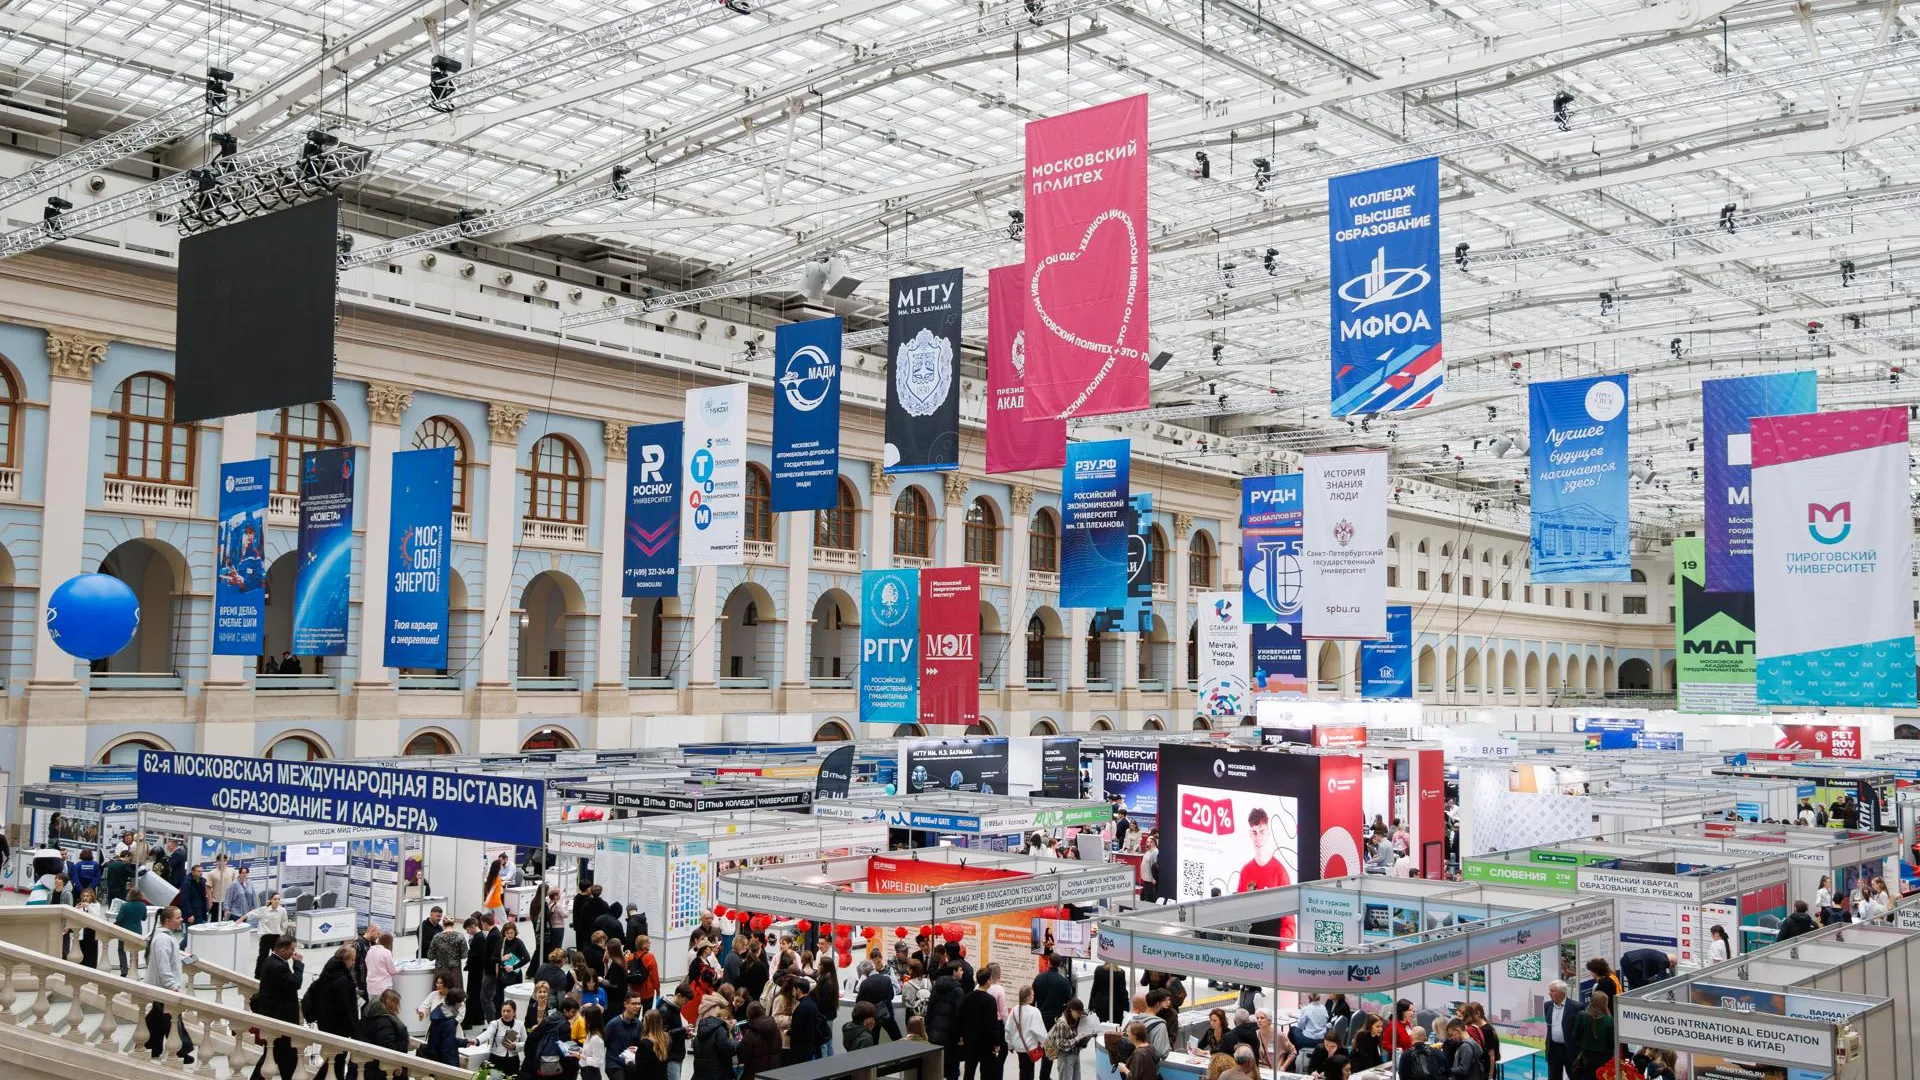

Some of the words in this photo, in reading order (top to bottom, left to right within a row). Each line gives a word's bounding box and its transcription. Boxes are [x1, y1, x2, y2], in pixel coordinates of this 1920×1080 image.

[1032, 139, 1137, 178] МОСКОВСКИЙ
[1349, 185, 1416, 208] КОЛЛЕДЖ
[1354, 204, 1412, 226] ВЫСШЕЕ
[1079, 210, 1108, 252] ПОЛИТЕХ
[1335, 214, 1431, 243] ОБРАЗОВАНИЕ
[1109, 207, 1138, 265] МОСКОВСКИЙ
[1045, 254, 1058, 265] ПО
[1031, 261, 1046, 297] ЛЮБВИ
[1126, 266, 1138, 306] ЛЮБВИ
[897, 282, 955, 309] МГТУ
[898, 308, 909, 316] ИМ.
[923, 303, 952, 313] БАУМАНА
[1122, 307, 1132, 323] ПО
[1033, 297, 1075, 345] МОСКОВСКИЙ
[1340, 308, 1432, 342] МФЮА
[1116, 325, 1127, 346] ЭТО
[1074, 337, 1113, 354] ПОЛИТЕХ
[1120, 347, 1138, 359] ЭТО
[808, 364, 836, 380] МАДИ
[1085, 355, 1117, 396] ПОЛИТЕХ
[1544, 424, 1605, 448] Лучшее
[707, 438, 713, 448] S
[1550, 446, 1604, 466] будущее
[696, 456, 709, 477] T
[1075, 459, 1117, 471] РЭУ.РФ
[1540, 460, 1617, 482] начинается
[1323, 468, 1366, 479] ИСТОРИЯ
[633, 483, 673, 497] РОСНОУ
[706, 482, 712, 492] E
[1326, 479, 1363, 490] ЗНАНИЯ
[1562, 474, 1602, 494] здесь!
[632, 495, 673, 506] УНИВЕРСИТЕТ
[691, 493, 699, 505] A
[1074, 489, 1117, 500] РОССИЙСКИЙ
[1250, 488, 1296, 504] РУДН
[1329, 491, 1359, 502] ЛЮДИ
[1066, 499, 1124, 510] ЭКОНОМИЧЕСКИЙ
[310, 512, 341, 522] «КОМЕТА»
[696, 509, 709, 524] M
[1073, 510, 1118, 520] УНИВЕРСИТЕТ
[1262, 513, 1290, 521] БАЛЛОВ
[1290, 511, 1302, 519] ЕГЭ
[414, 525, 438, 547] МОС
[413, 549, 437, 570] ОБЛ
[1306, 549, 1384, 560] Санкт-Петербургский
[1786, 548, 1878, 562] ПИРОГОВСКИЙ
[1312, 557, 1376, 568] государственный
[1787, 562, 1877, 574] УНИВЕРСИТЕТ
[633, 568, 647, 578] (499)
[648, 567, 675, 577] 321-24-68
[1320, 567, 1367, 576] университет
[394, 571, 436, 592] ЭНЕРГО
[220, 606, 238, 616] ВРЕМЯ
[238, 606, 258, 617] ДЕЛАТЬ
[1325, 604, 1360, 615] spbu.ru
[219, 618, 242, 628] СМЕЛЫЕ
[242, 618, 257, 627] ШАГИ
[394, 620, 410, 630] Твоя
[411, 621, 438, 633] карьера
[391, 636, 396, 644] в
[396, 635, 440, 647] энергетике!
[926, 633, 974, 657] МЭИ
[1208, 641, 1238, 650] Мечтай,
[1683, 640, 1757, 655] МАП
[863, 638, 913, 663] РГГУ
[1211, 651, 1235, 659] Учись,
[1212, 659, 1235, 667] Твори
[871, 676, 906, 684] РОССИЙСКИЙ
[864, 684, 913, 692] ГОСУДАРСТВЕННЫЙ
[1831, 730, 1853, 740] PET
[1832, 740, 1856, 749] ROV
[1105, 749, 1158, 760] УНИВЕРСИТ
[1831, 748, 1857, 757] SKY.
[1105, 761, 1158, 772] ТАЛАНТЛИВ
[143, 753, 171, 774] 62-я
[174, 755, 273, 783] МОСКОВСКАЯ
[277, 763, 427, 799] МЕЖДУНАРОДНАЯ
[432, 776, 538, 810] ВЫСТАВКА
[829, 772, 848, 780] IThub
[1106, 772, 1139, 783] ЛЮДЕЙ
[624, 797, 641, 805] IThub
[650, 798, 667, 807] IThub
[676, 800, 693, 809] IThub
[705, 800, 724, 809] IThub
[725, 798, 755, 807] КОЛЛЕДЖ
[758, 795, 799, 805] УНИВЕРСИТЕТ
[211, 787, 332, 821] «ОБРАЗОВАНИЕ
[336, 800, 348, 822] И
[352, 802, 439, 833] КАРЬЕРА»
[1184, 802, 1212, 827] -20
[1216, 806, 1232, 829] %
[1067, 879, 1082, 888] CHINA
[1082, 877, 1102, 887] CAMPUS
[1103, 874, 1126, 884] NETWORK
[1594, 875, 1641, 885] ЛАТИНСКИЙ
[1642, 880, 1679, 889] КВАРТАЛ
[940, 893, 971, 906] ZHEJIANG
[971, 891, 987, 902] XIPEI
[987, 887, 1021, 901] EDUCATION
[1021, 882, 1058, 896] TECHNOLOGY
[1580, 881, 1637, 894] ОБРАЗОВАНИЕ
[1652, 888, 1693, 899] РУБЕЖОМ
[773, 895, 797, 905] EDUCATION
[798, 899, 828, 909] TECHNOLOGY
[946, 904, 980, 915] ОБУЧЕНИЕ
[980, 903, 984, 911] В
[985, 895, 1034, 910] УНИВЕРСИТЕТАХ
[1034, 893, 1052, 902] КИТАЯ
[1327, 899, 1350, 909] туризме
[1310, 907, 1333, 917] Южной
[1142, 945, 1162, 956] Едем
[1163, 948, 1194, 961] учиться
[1201, 953, 1232, 969] Южную
[1233, 957, 1264, 971] Корею!
[1298, 966, 1325, 977] Imagine
[1327, 968, 1344, 978] your
[1347, 964, 1381, 981] Korea
[1622, 1010, 1676, 1026] MINGYANG
[1677, 1017, 1753, 1037] INTRNATIONAL
[1756, 1029, 1820, 1046] EDUCATION
[1653, 1025, 1734, 1044] (ОБРАЗОВАНИЕ
[1737, 1037, 1745, 1046] В
[1747, 1039, 1786, 1053] КИТАЕ)
[1715, 1065, 1766, 1078] MINGYANG.RU
